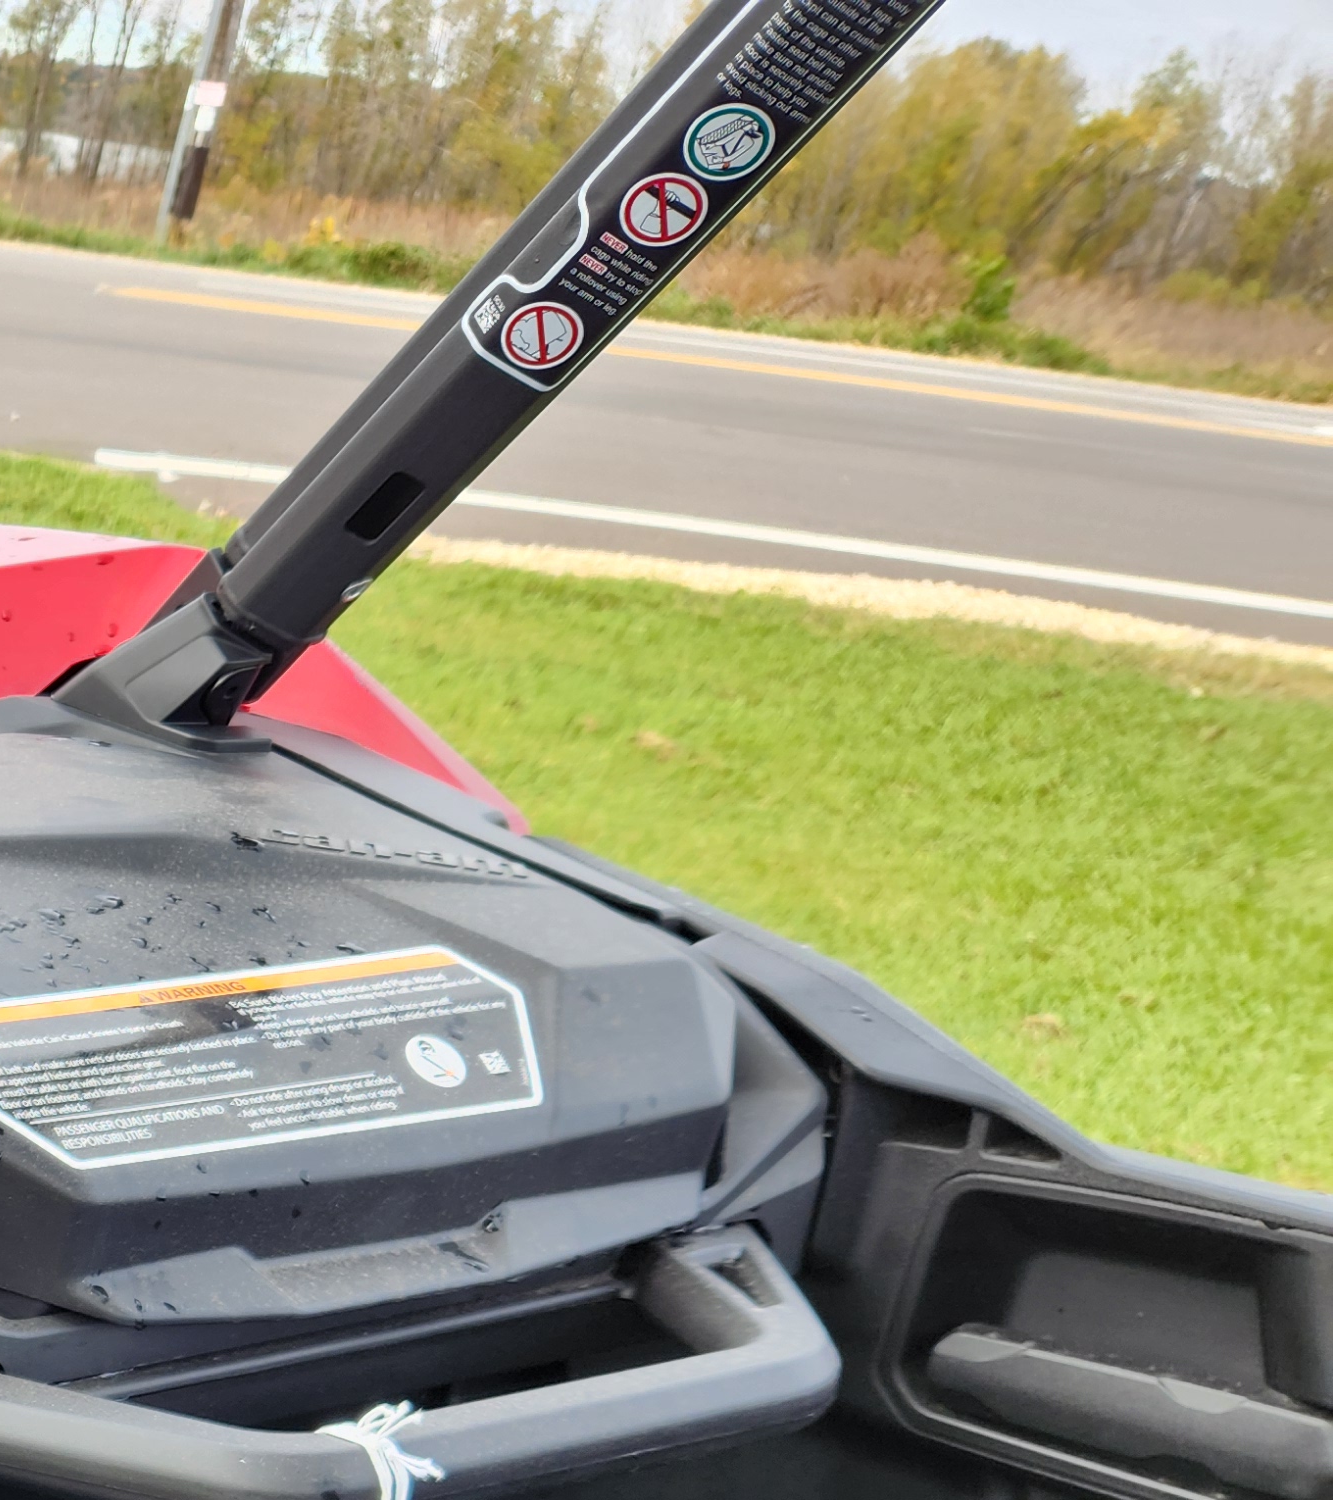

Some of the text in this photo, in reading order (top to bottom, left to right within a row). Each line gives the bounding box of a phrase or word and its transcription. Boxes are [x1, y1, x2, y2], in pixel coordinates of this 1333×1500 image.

[753, 32, 835, 92] make sure net and/or
[762, 21, 843, 82] Fasten seat belt and
[735, 51, 809, 109] in place to help you
[744, 42, 834, 104] door is securely latched
[725, 62, 812, 124] avoid sticking out arms
[591, 246, 610, 262] cage
[611, 257, 632, 273] while
[602, 233, 657, 272] NEVER hold the
[559, 278, 577, 293] your
[577, 290, 593, 301] arm
[594, 297, 603, 306] or
[577, 270, 605, 291] rollover
[606, 289, 627, 306] using
[581, 255, 643, 296] NEVER try to stop
[152, 981, 247, 1003] WARNING
[54, 1105, 225, 1136] PASSENGER QUALIFICATIONS AND
[60, 1129, 152, 1150] RESPONSIBILITIES
